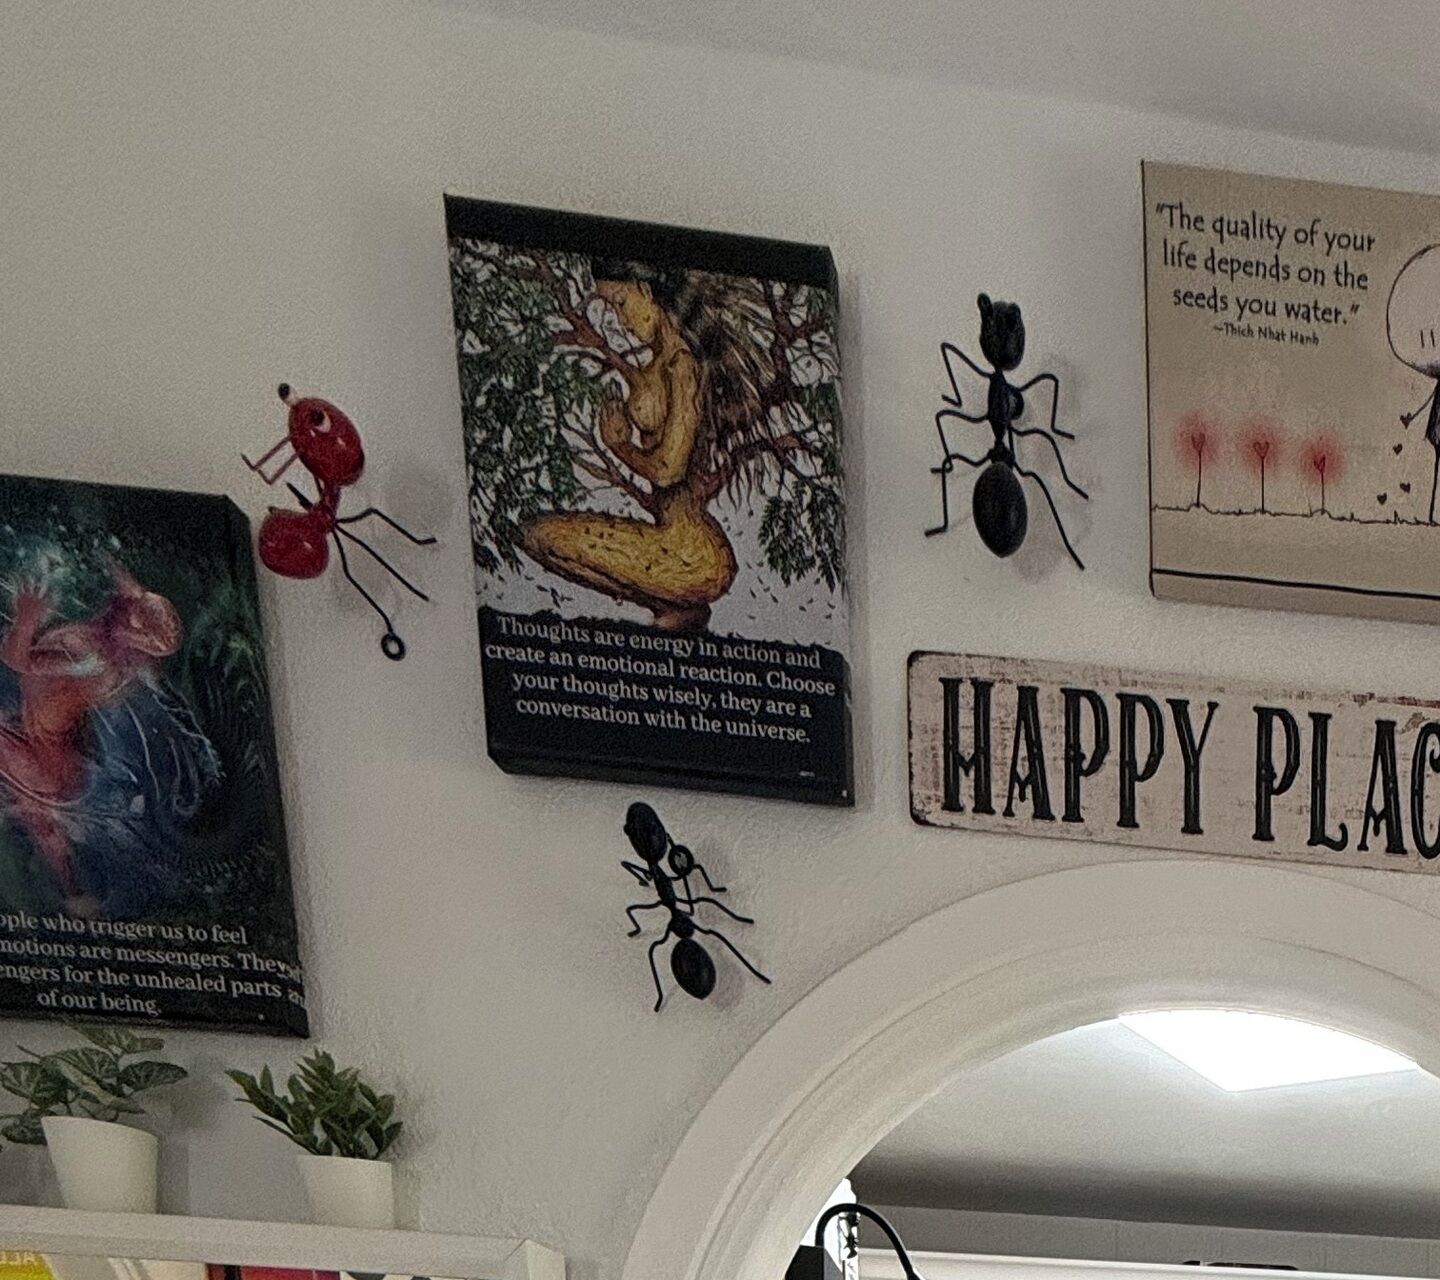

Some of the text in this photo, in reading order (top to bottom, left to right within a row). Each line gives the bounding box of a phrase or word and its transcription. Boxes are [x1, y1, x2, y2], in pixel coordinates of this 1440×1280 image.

[1155, 202, 1375, 256] "The quality of your
[1173, 287, 1360, 324] seeds you water."
[1258, 328, 1286, 342] Nhat
[1290, 331, 1319, 345] Hanh
[498, 617, 820, 669] Thoughts are energy in action and
[516, 699, 810, 743] conversation with the universe.
[939, 676, 1219, 835] HAPPY
[43, 916, 85, 933] who
[90, 921, 156, 940] trigger
[161, 927, 183, 940] us
[188, 926, 208, 941] to
[212, 925, 248, 944] feel
[38, 989, 57, 1006] of
[62, 994, 97, 1009] our
